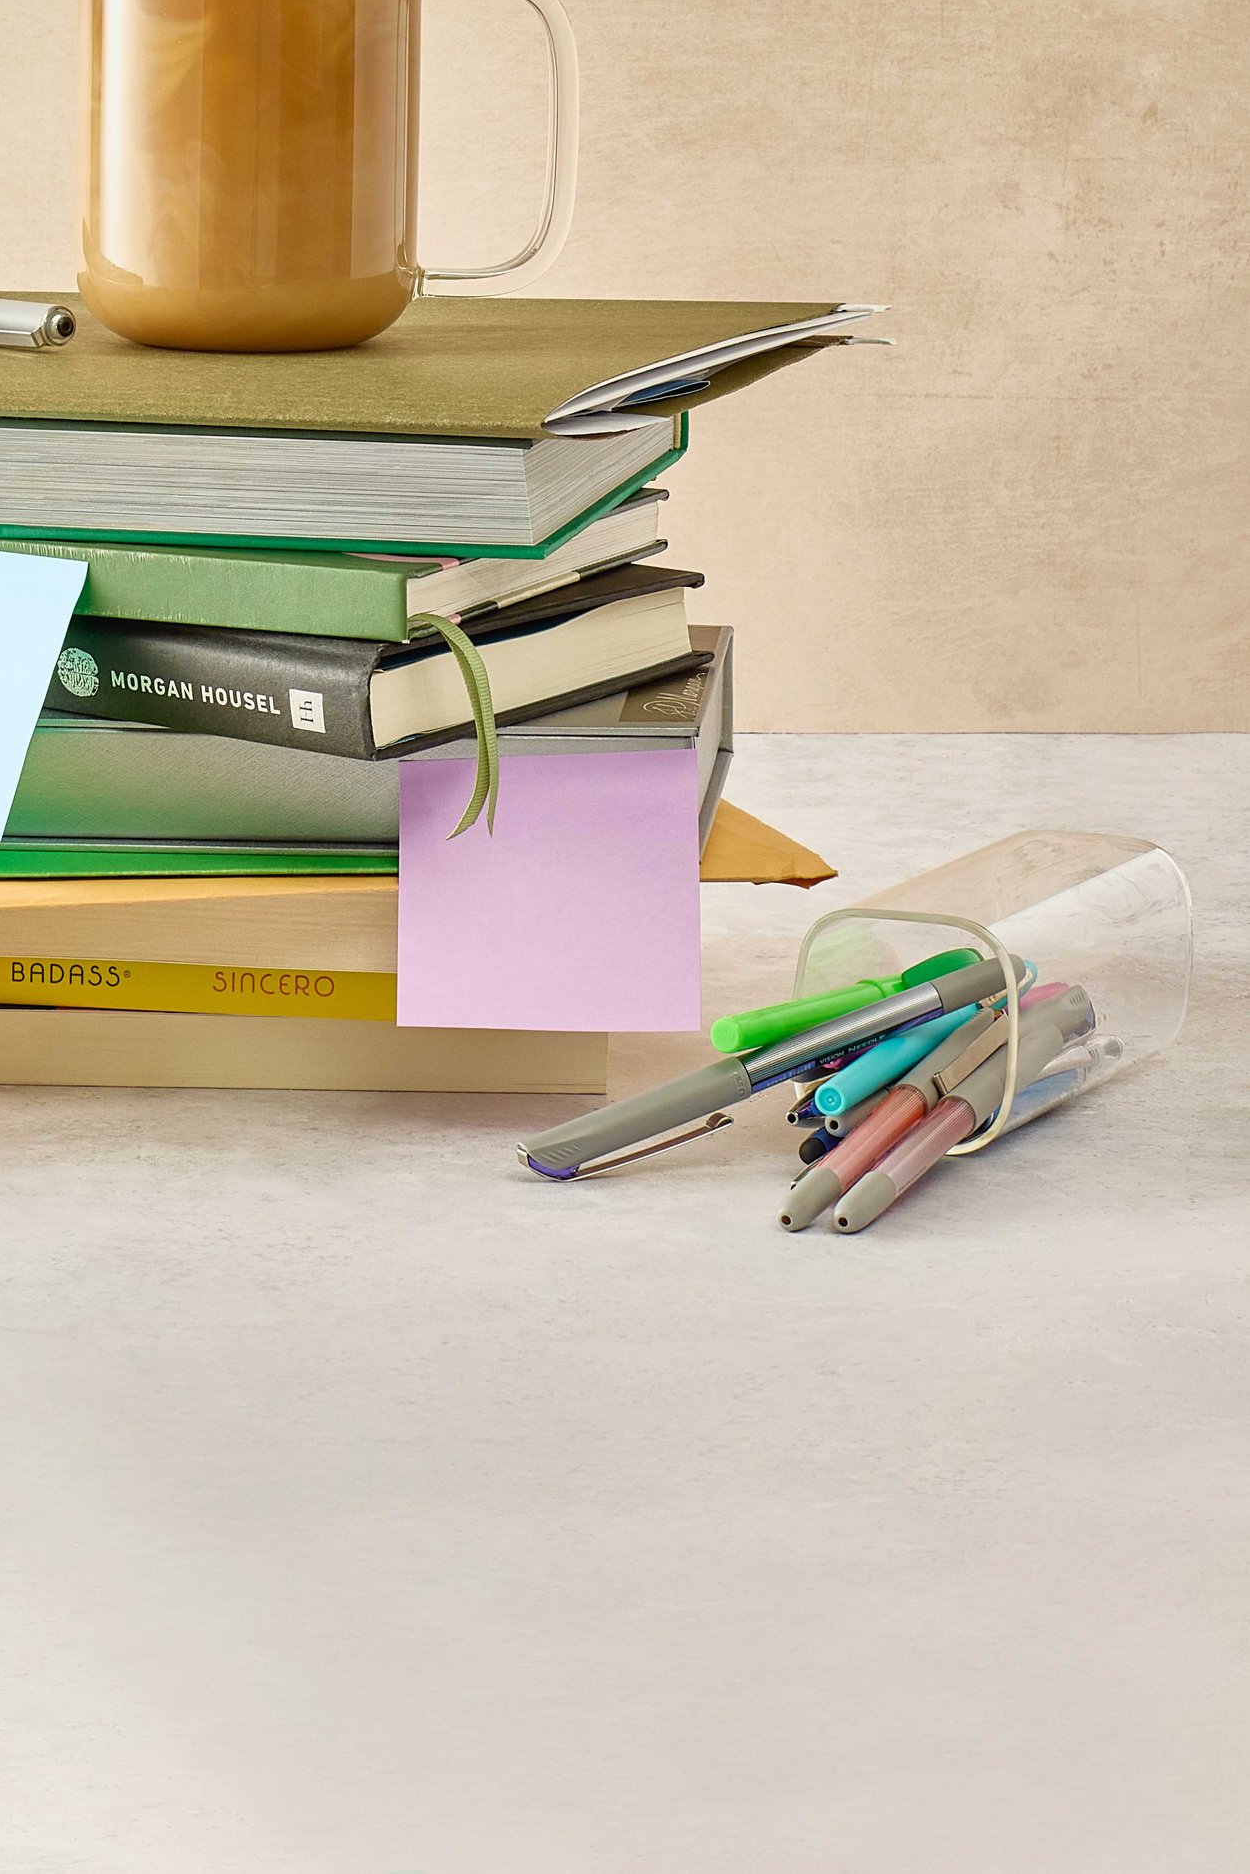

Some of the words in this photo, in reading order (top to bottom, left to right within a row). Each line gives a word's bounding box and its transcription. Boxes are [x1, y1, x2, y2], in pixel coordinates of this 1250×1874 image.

[111, 670, 194, 701] MORGAN
[201, 685, 281, 715] HOUSEL
[212, 971, 335, 997] SINCERO
[819, 1050, 845, 1064] VISION
[847, 1034, 886, 1053] NEEDLE
